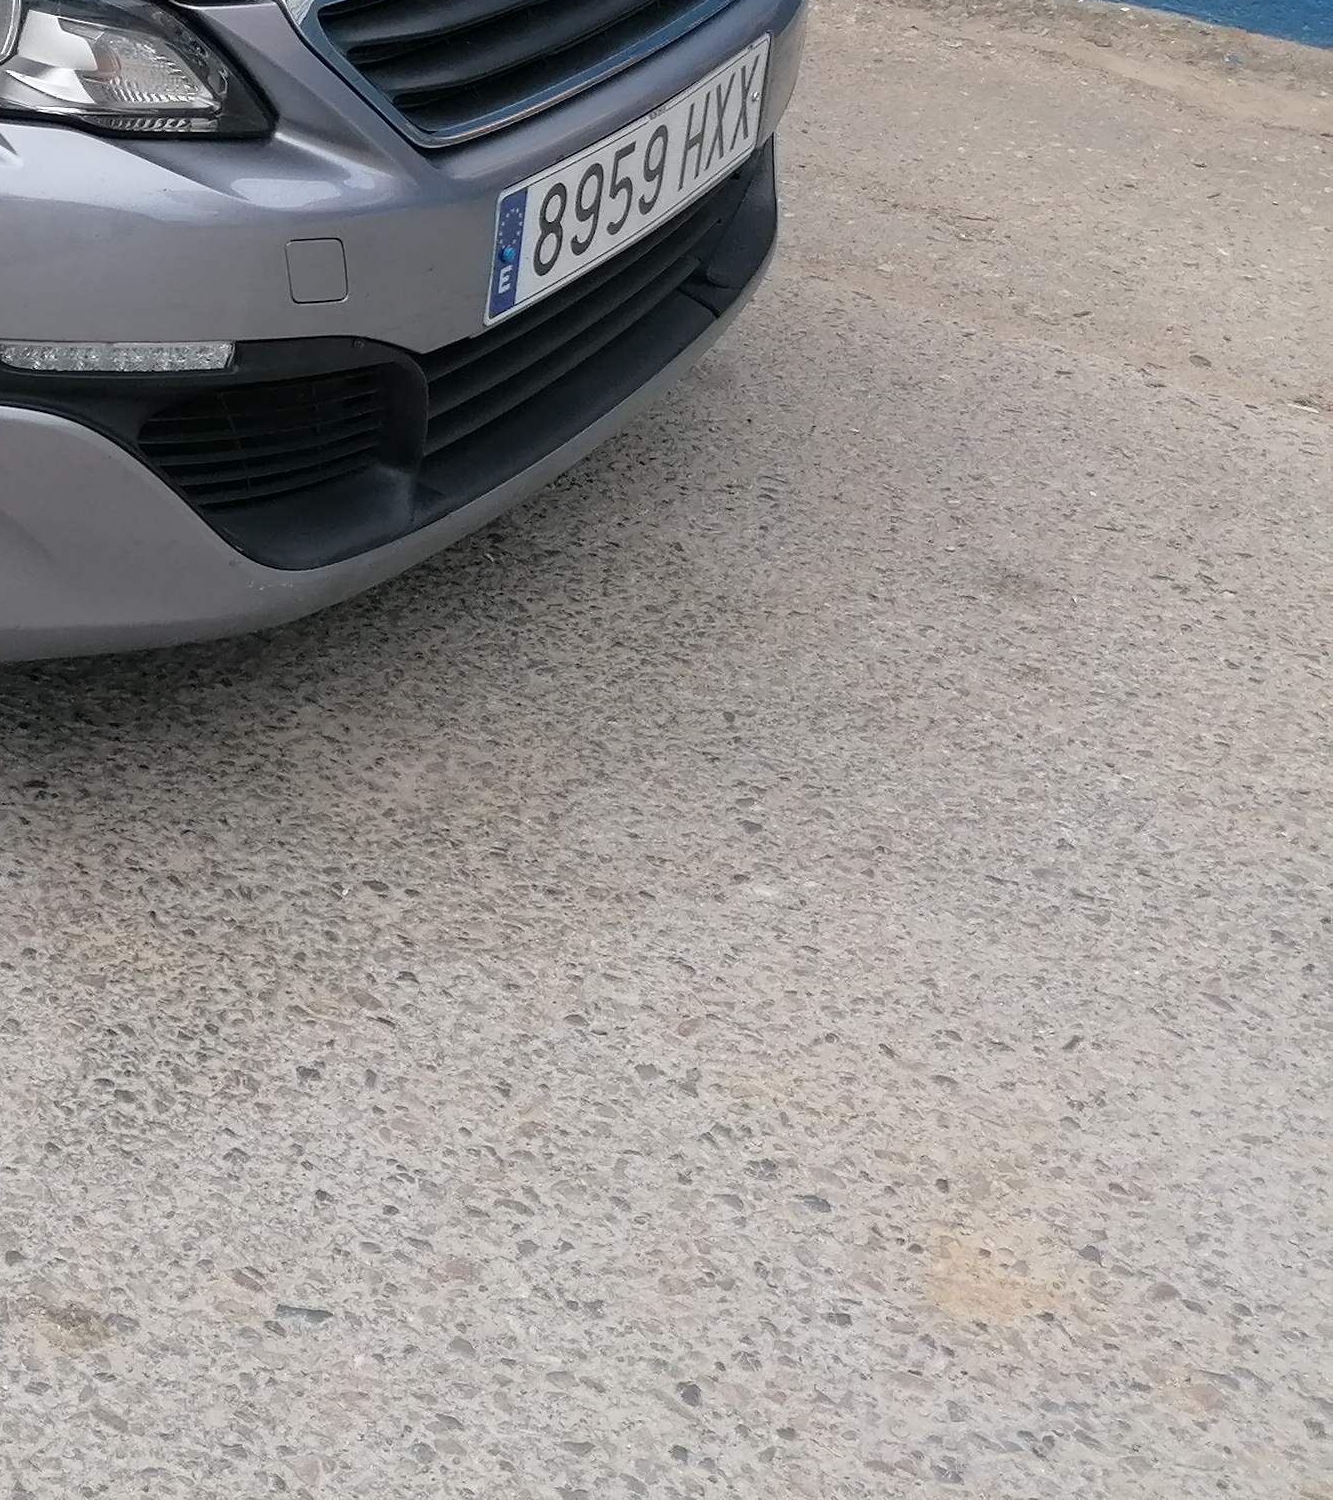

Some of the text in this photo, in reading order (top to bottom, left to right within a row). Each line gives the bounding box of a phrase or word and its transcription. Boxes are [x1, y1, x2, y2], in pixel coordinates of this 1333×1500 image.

[497, 54, 760, 295] E 8959 HXX
